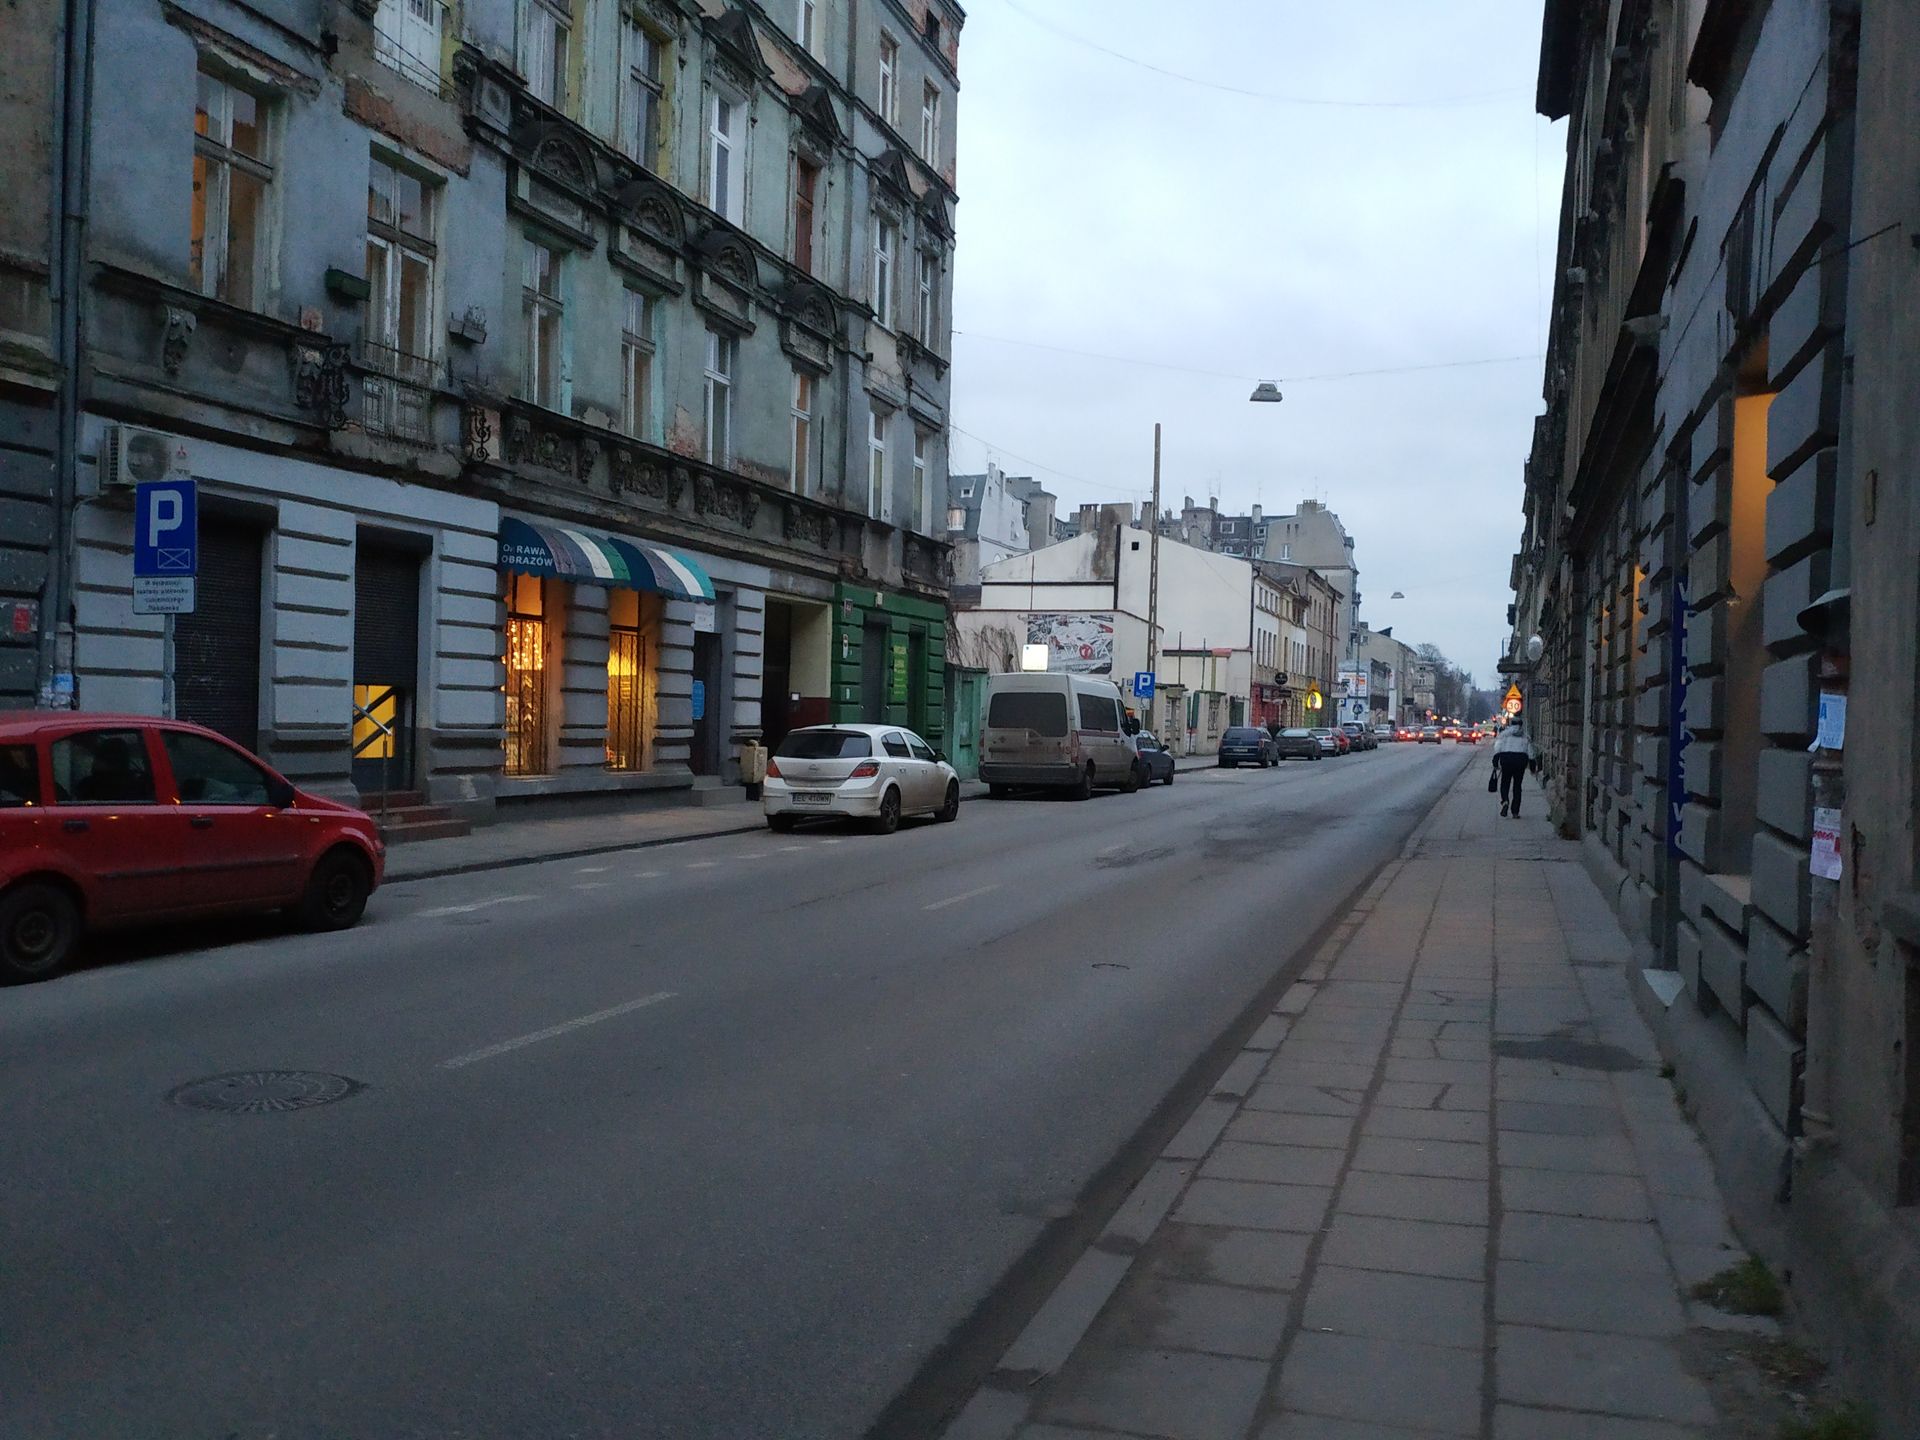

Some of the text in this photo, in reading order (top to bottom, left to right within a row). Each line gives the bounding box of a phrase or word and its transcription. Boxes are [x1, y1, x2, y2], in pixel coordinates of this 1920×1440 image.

[149, 489, 183, 547] P
[502, 544, 545, 555] ORAWA
[501, 555, 553, 566] OBRAZÓW
[1138, 674, 1151, 690] P
[1508, 702, 1519, 710] 30
